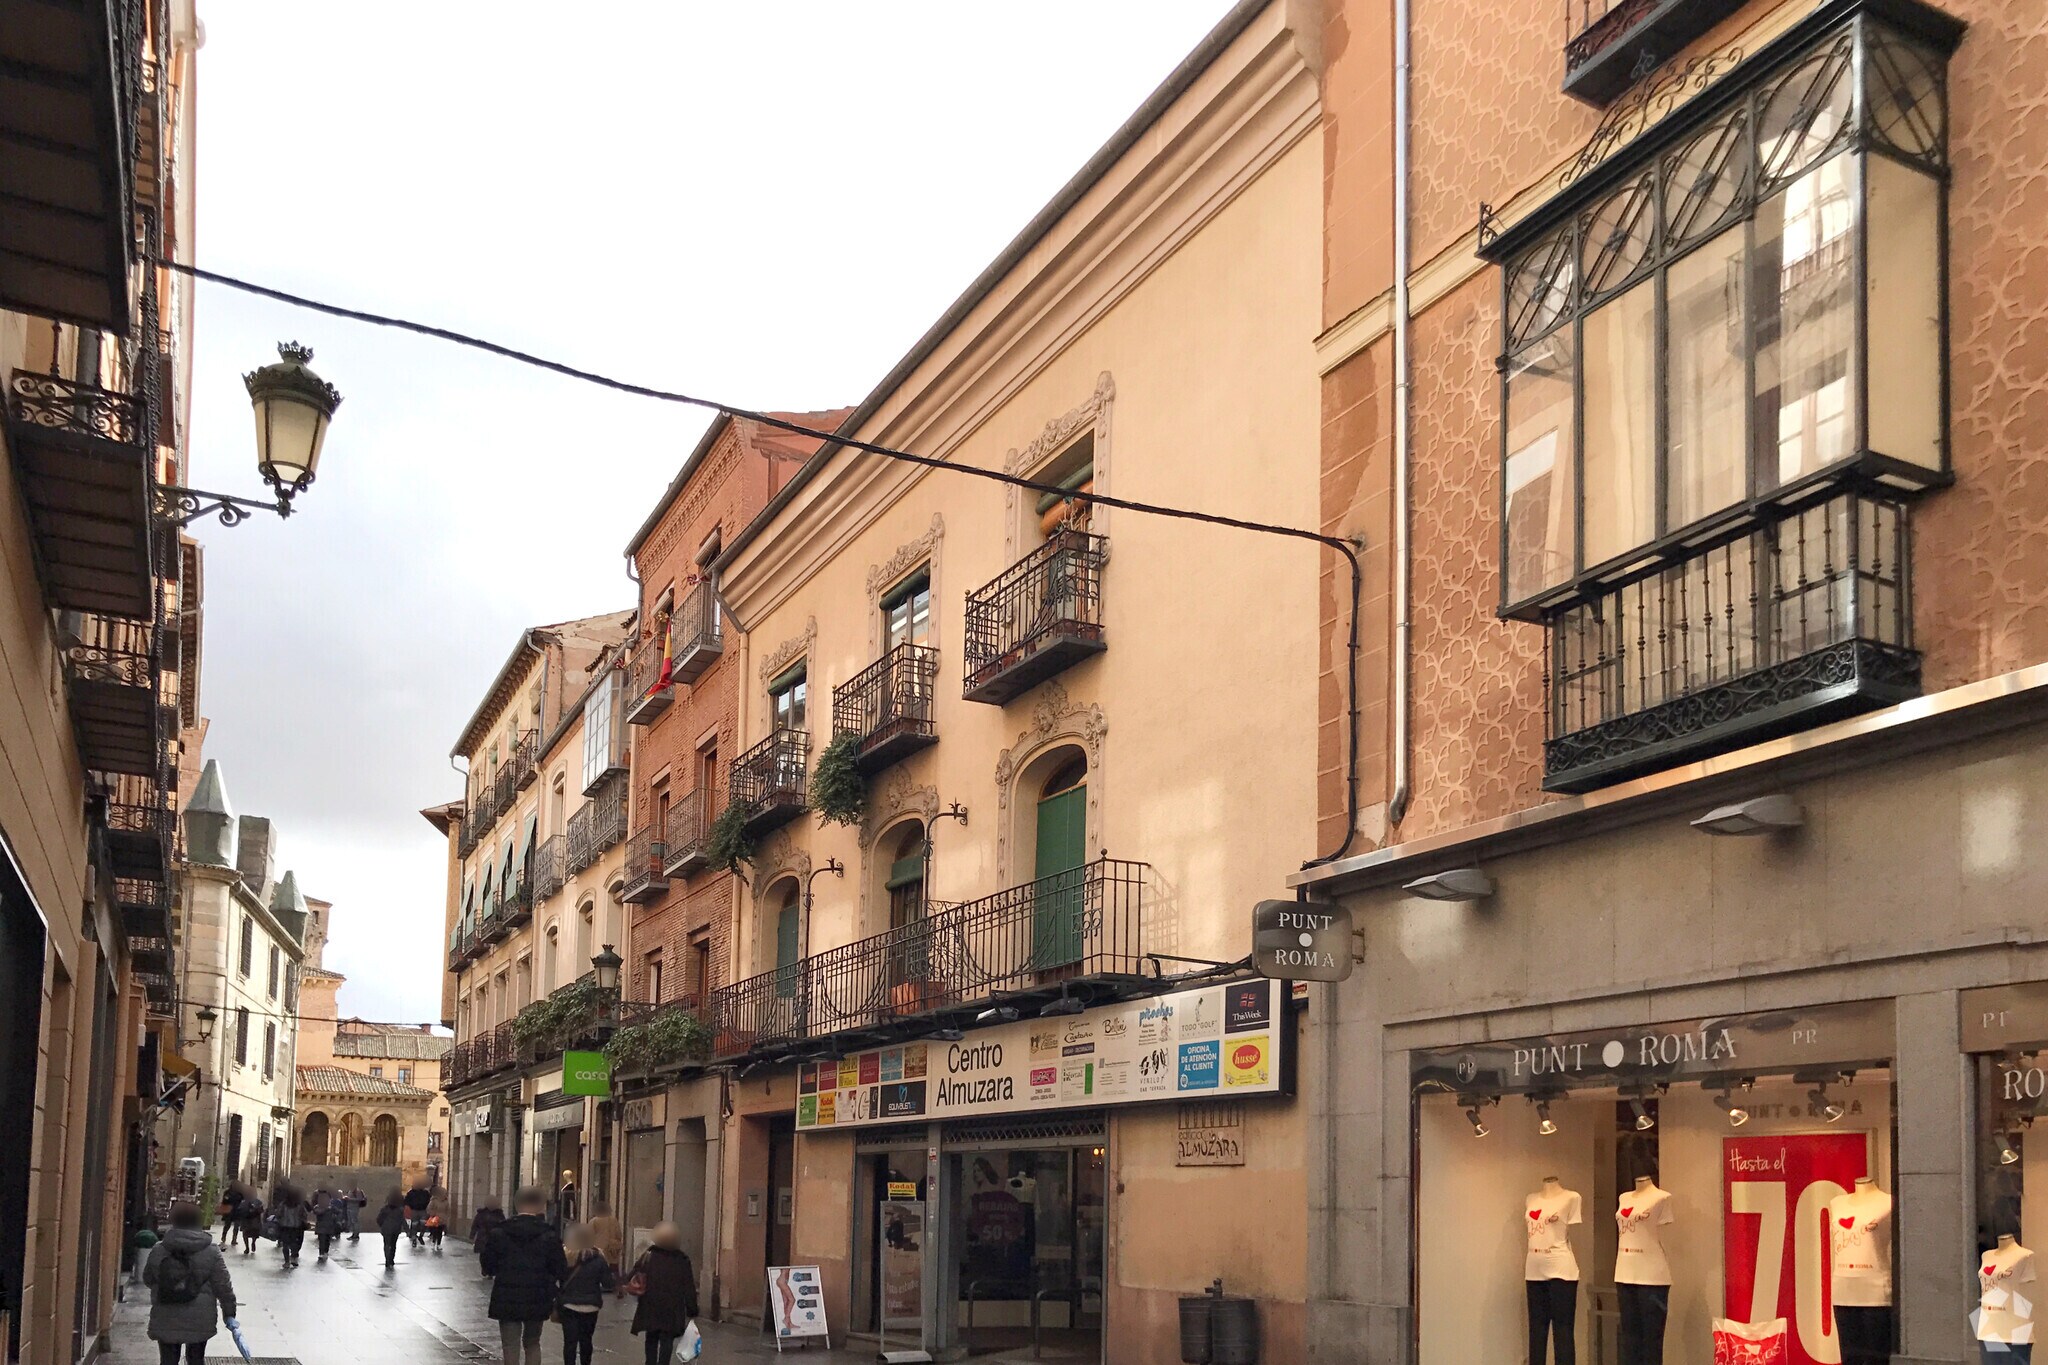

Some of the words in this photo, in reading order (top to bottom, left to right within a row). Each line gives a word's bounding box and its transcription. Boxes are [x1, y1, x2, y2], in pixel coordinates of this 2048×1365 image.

[1278, 912, 1333, 931] PUNT
[1275, 949, 1335, 968] ROMA
[948, 1041, 1003, 1073] Centro
[1187, 1045, 1210, 1054] OFICINA
[1189, 1051, 1217, 1062] ATENCIÓN
[1513, 1043, 1588, 1076] PUNT
[1640, 1029, 1737, 1068] ROMA
[1192, 1062, 1214, 1070] CLIENTE
[575, 1071, 608, 1081] casa
[936, 1076, 1013, 1107] Almuzara
[1729, 1148, 1771, 1172] Hasta
[1773, 1147, 1786, 1174] el
